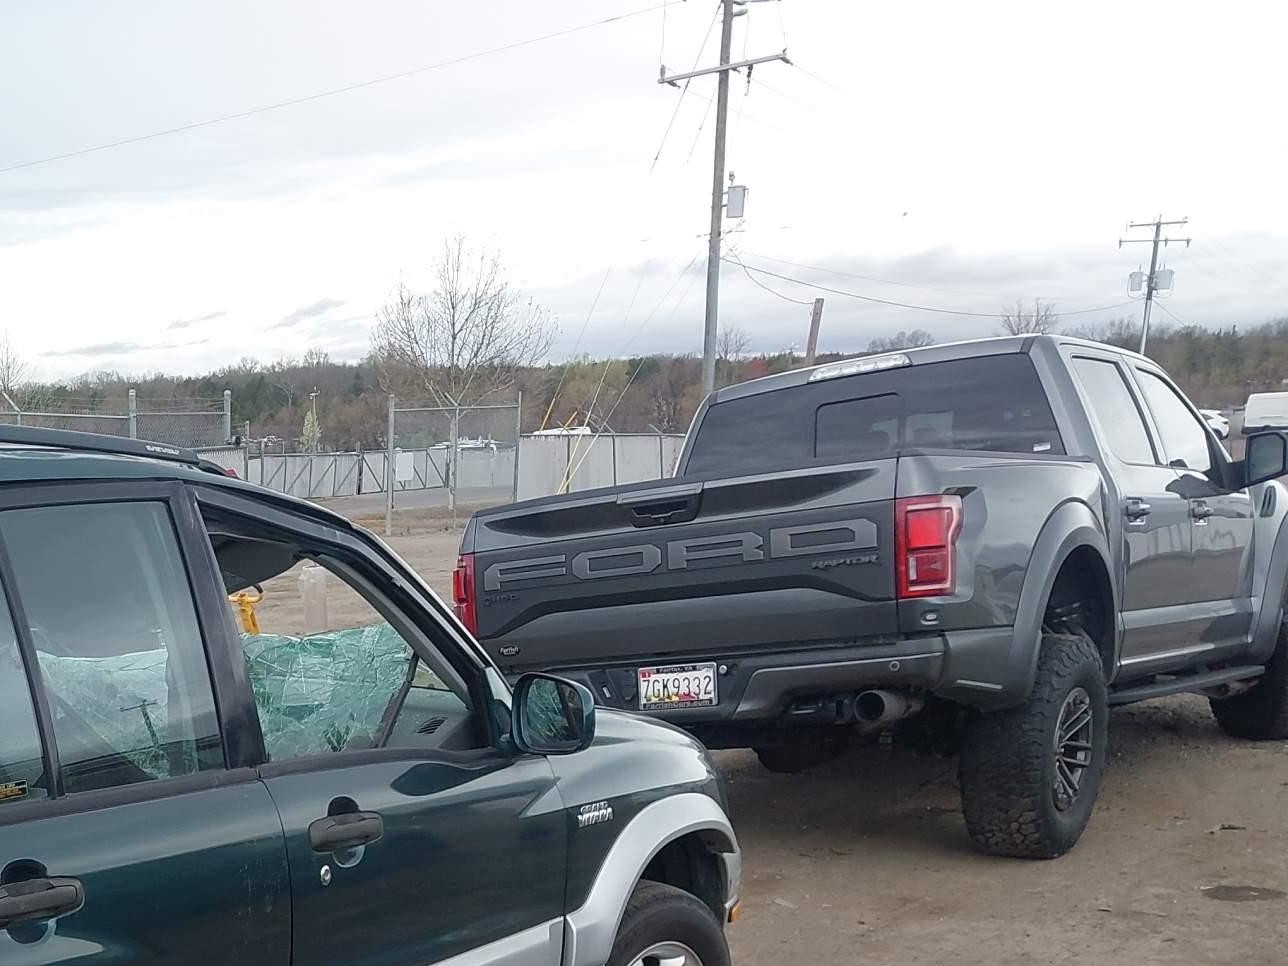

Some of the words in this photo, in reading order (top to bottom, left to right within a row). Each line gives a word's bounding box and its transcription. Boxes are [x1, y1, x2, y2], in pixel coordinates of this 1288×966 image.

[483, 518, 879, 592] FORD
[811, 555, 880, 570] RAPTOR
[642, 675, 712, 699] 7GK9332
